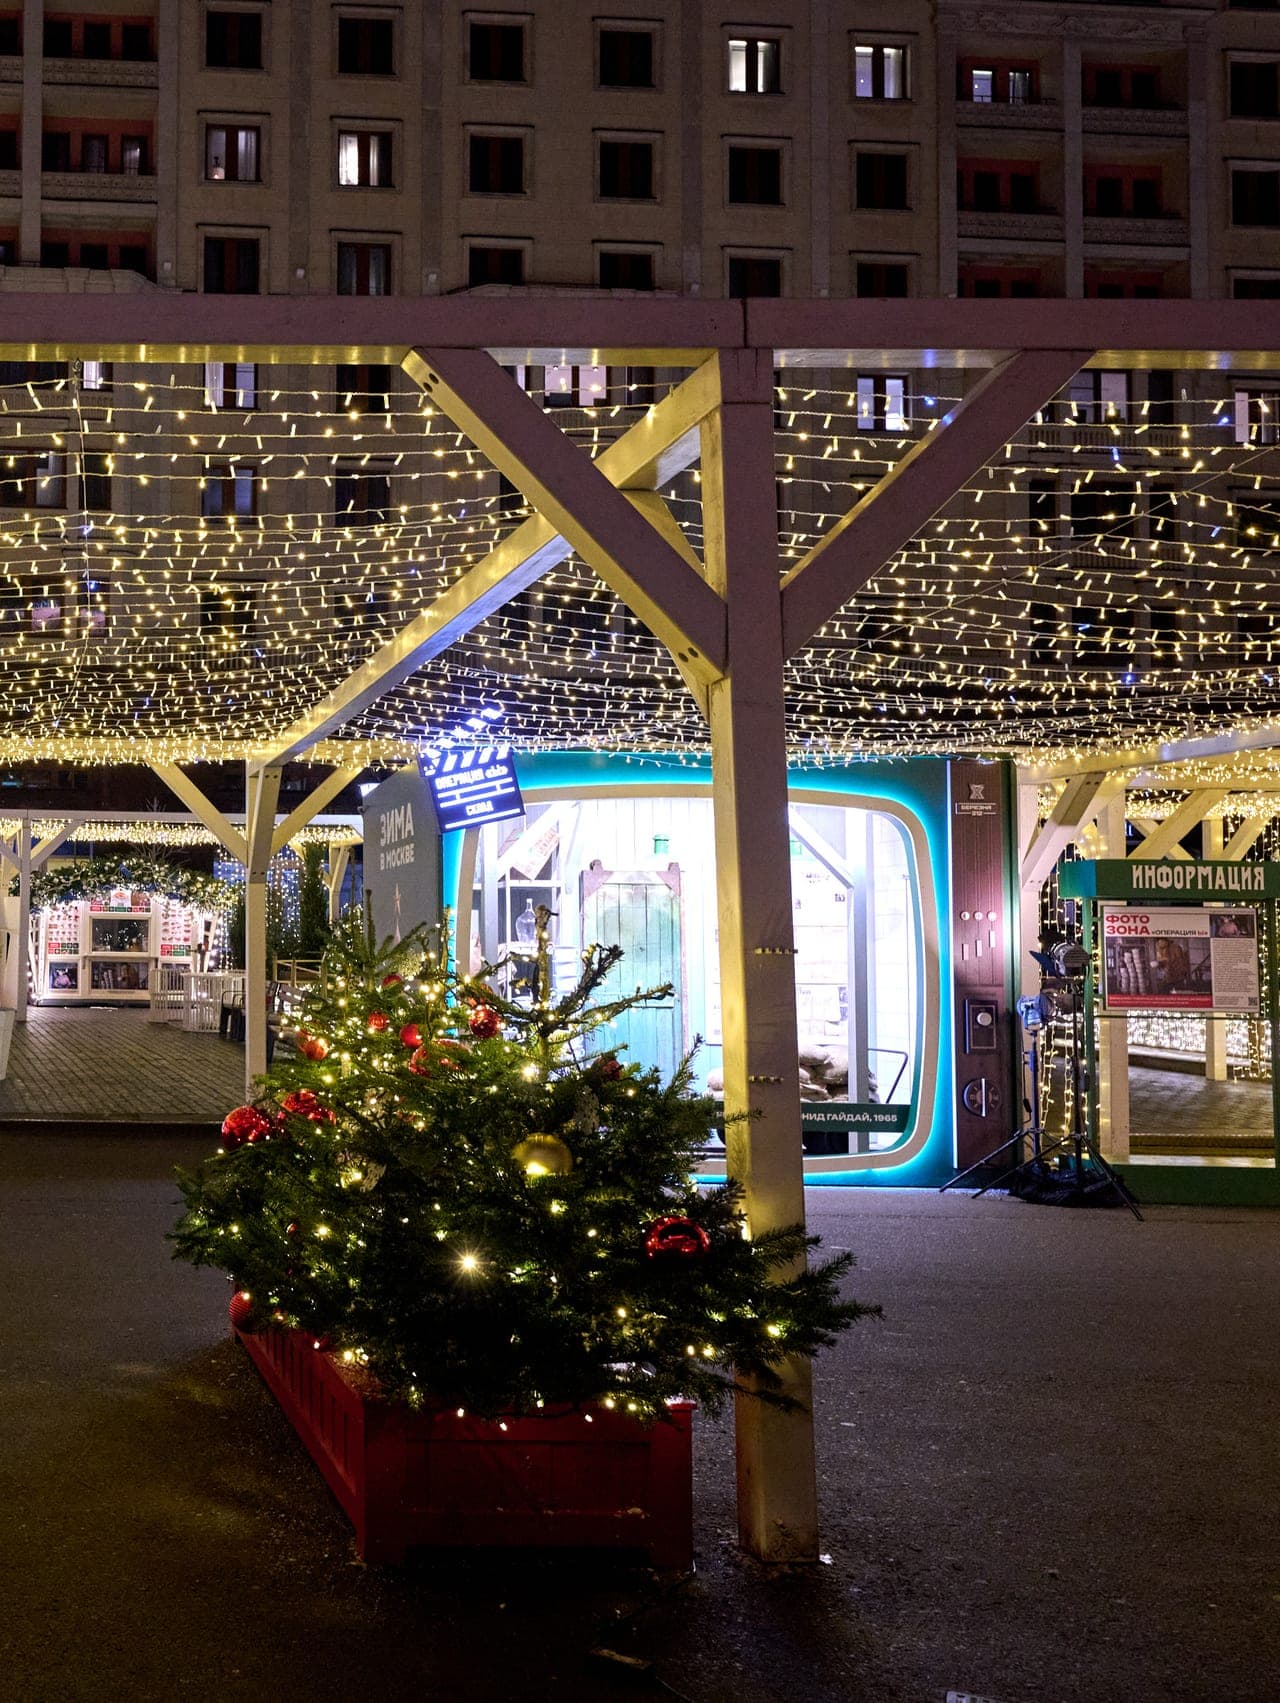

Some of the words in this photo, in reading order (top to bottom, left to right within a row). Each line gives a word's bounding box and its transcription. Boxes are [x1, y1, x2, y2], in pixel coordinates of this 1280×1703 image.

[380, 802, 414, 847] ЗИМА
[380, 853, 385, 871] В
[386, 843, 415, 870] МОСКВЕ
[1131, 864, 1265, 892] ИНФОРМАЦИЯ
[1106, 914, 1150, 924] ФОТО
[1106, 925, 1151, 935] ЗОНА
[802, 1113, 825, 1122] НИД
[826, 1112, 872, 1122] ГАЙДАЙ,
[873, 1114, 898, 1122] 1965
